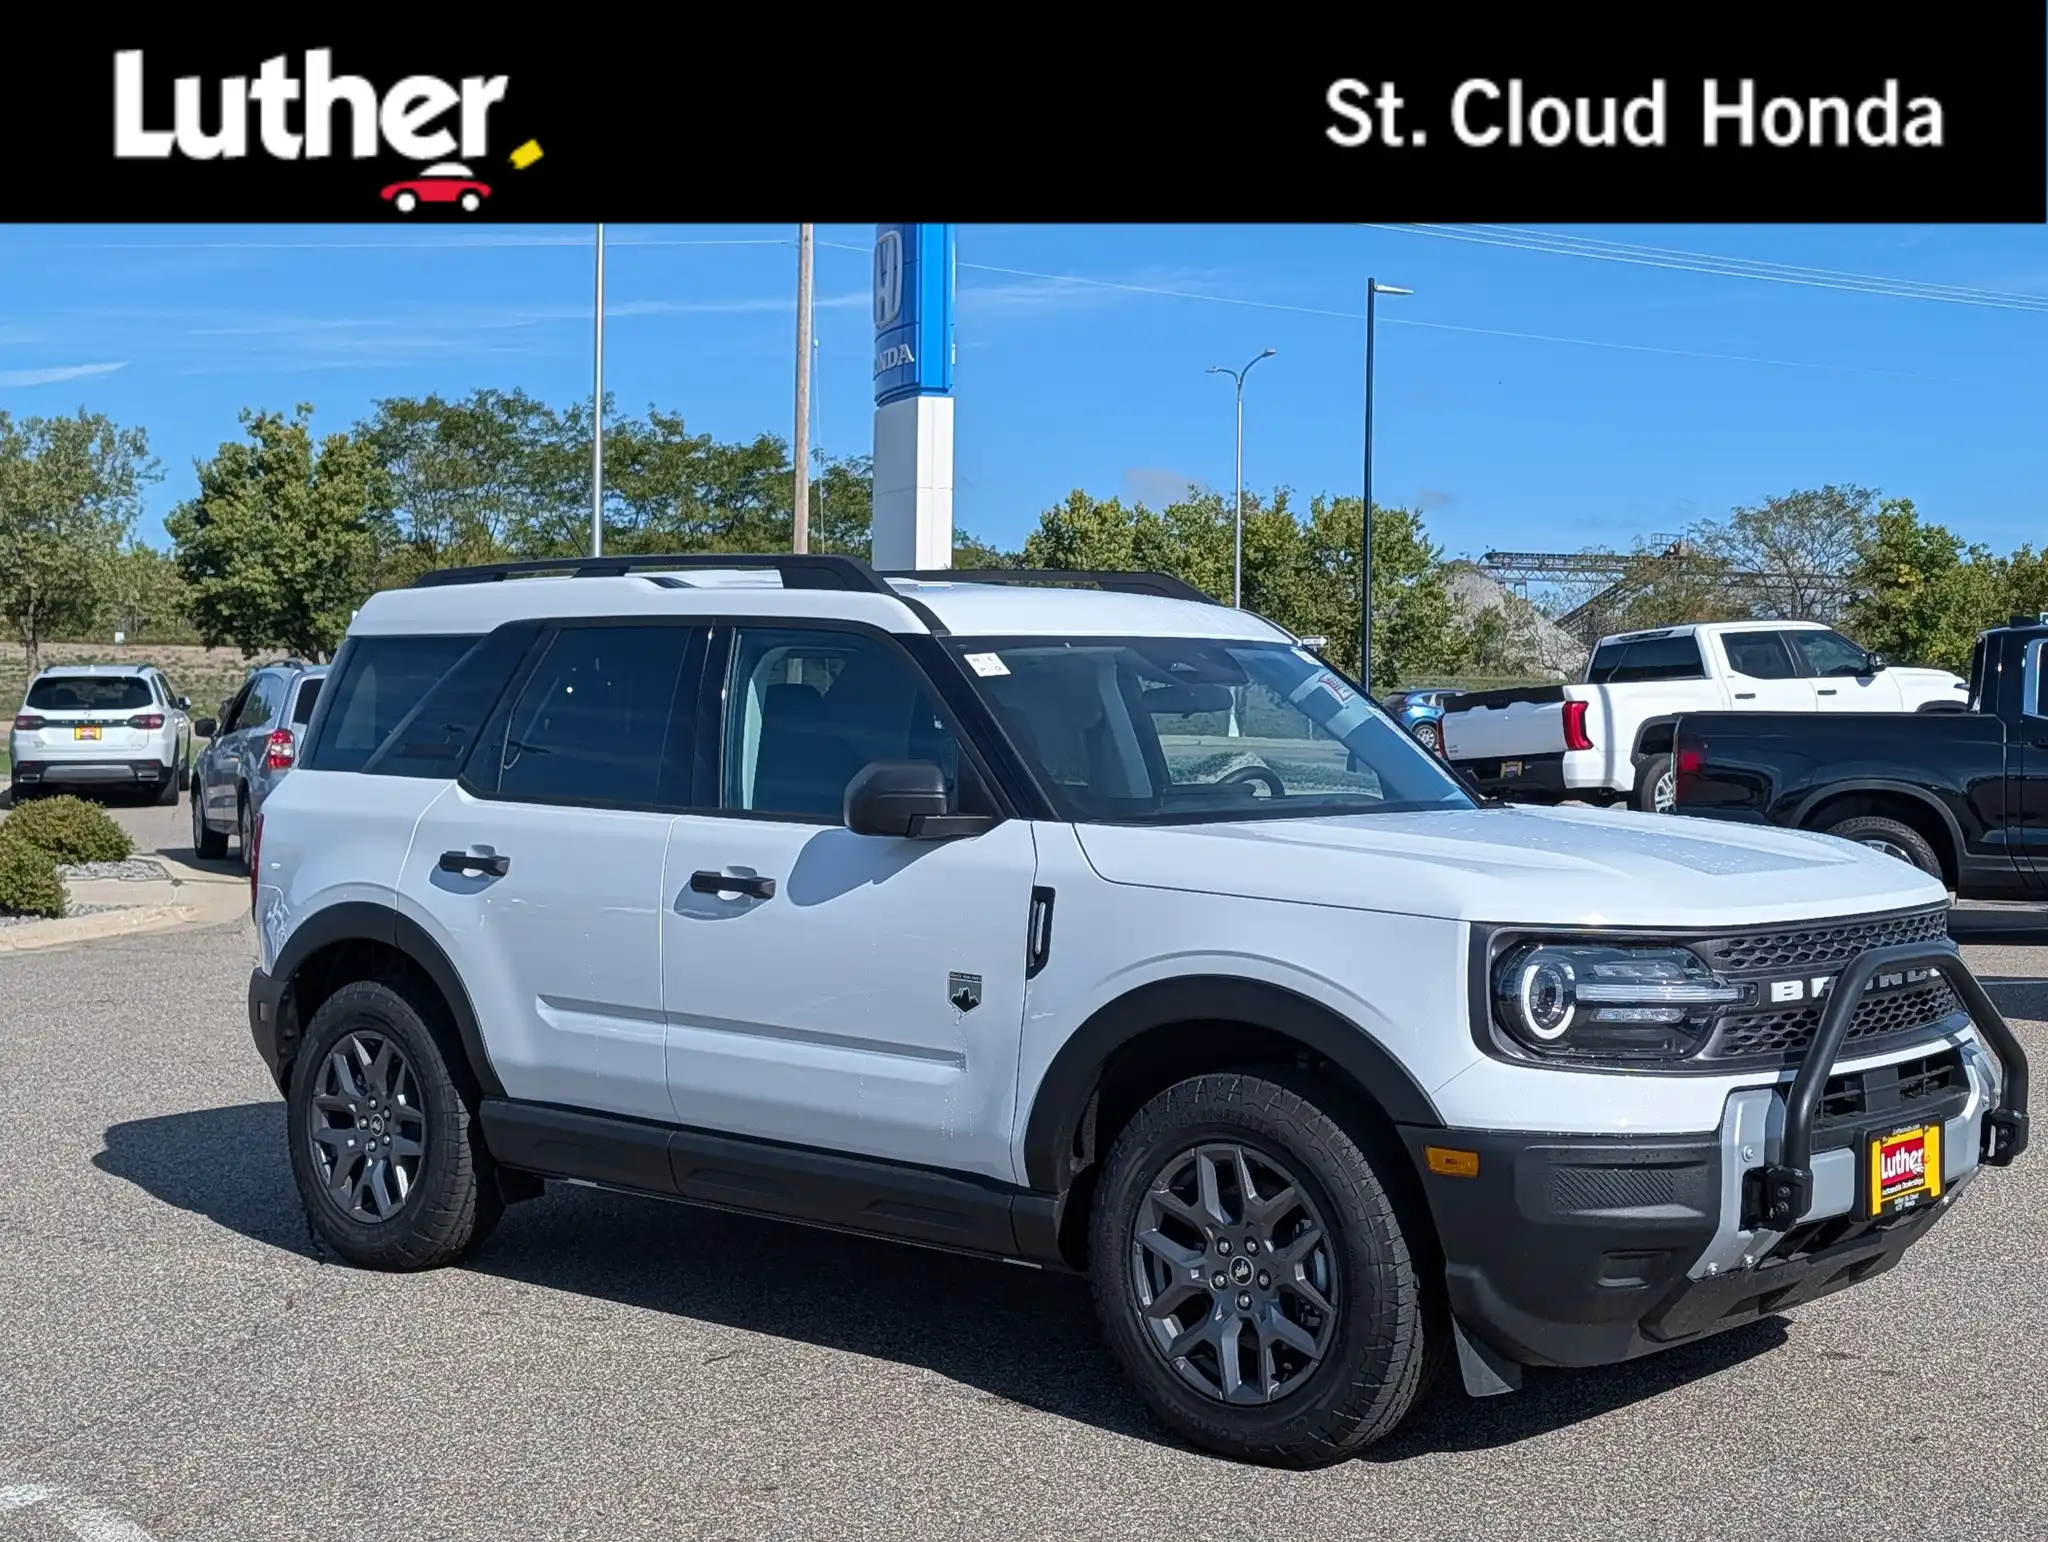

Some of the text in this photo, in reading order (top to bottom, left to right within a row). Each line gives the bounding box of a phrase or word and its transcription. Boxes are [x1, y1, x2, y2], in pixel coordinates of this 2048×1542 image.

[872, 343, 915, 374] ONDA
[1770, 967, 1941, 1003] BRNC
[1881, 1147, 1924, 1179] Luther
